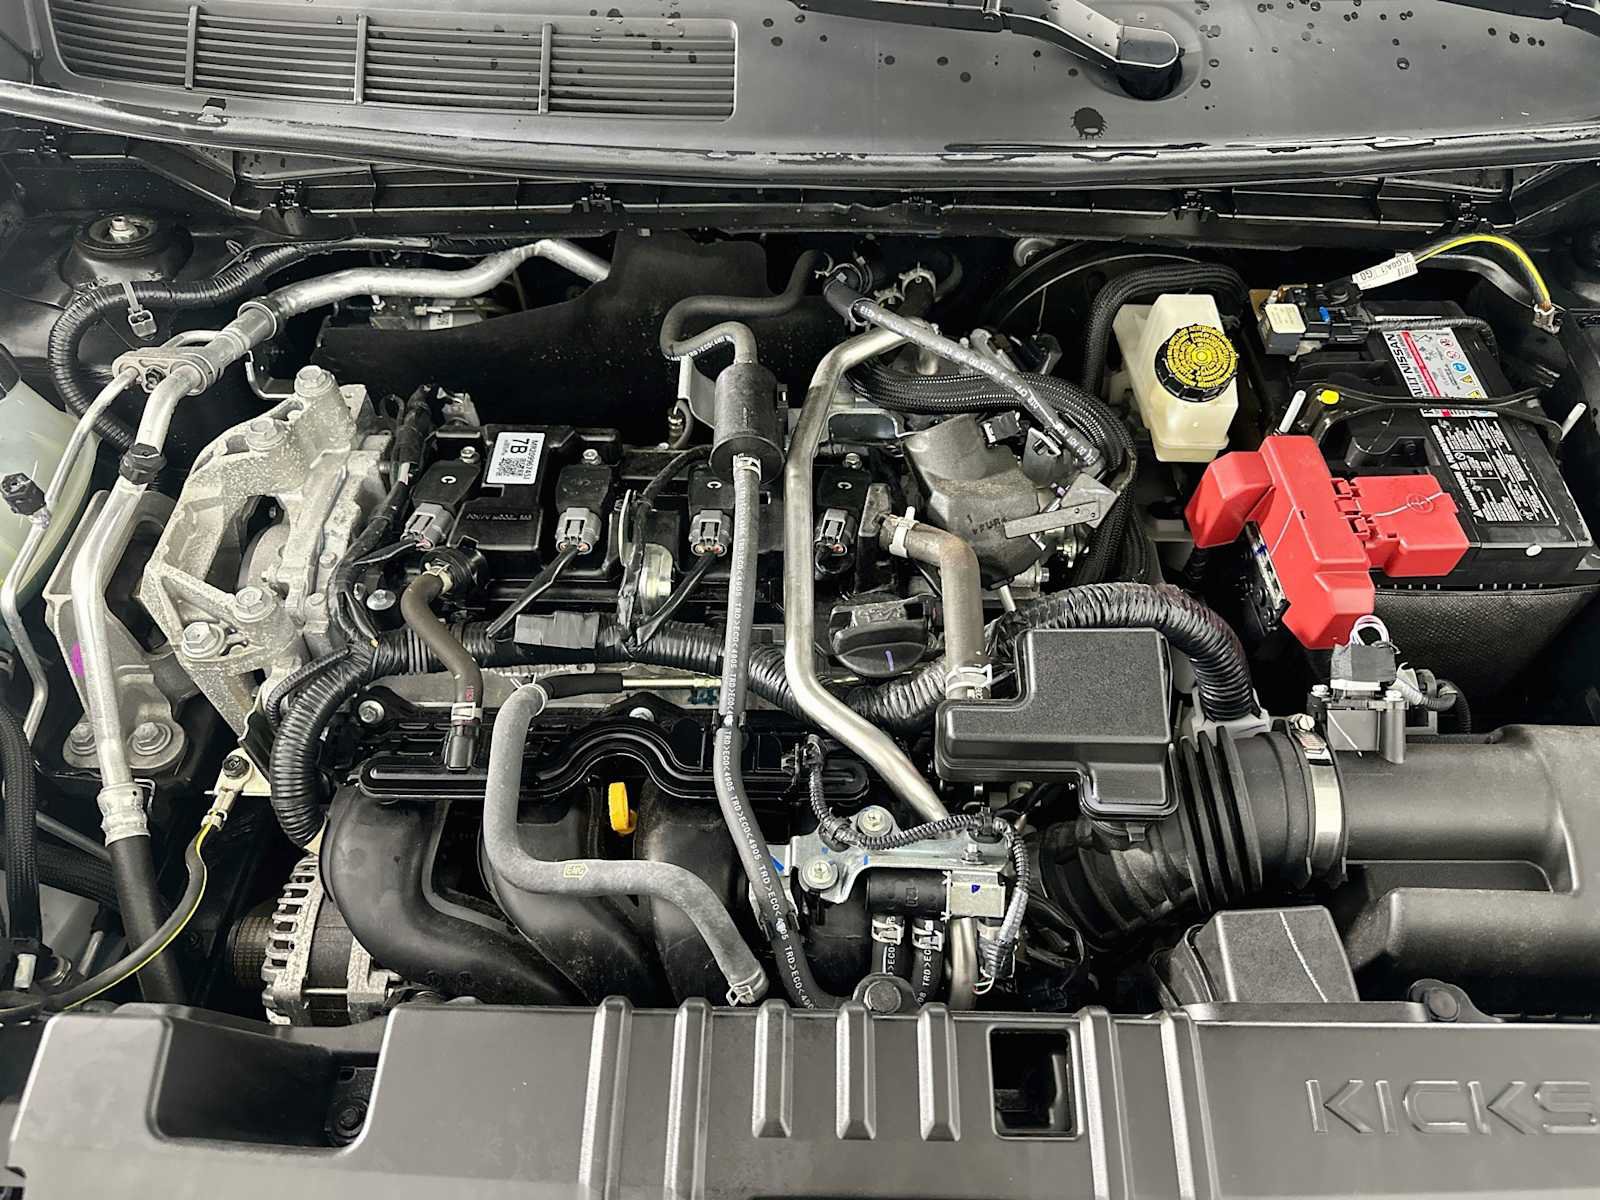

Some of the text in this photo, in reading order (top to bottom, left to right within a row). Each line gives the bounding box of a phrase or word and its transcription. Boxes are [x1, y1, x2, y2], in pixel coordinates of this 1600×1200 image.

[1385, 333, 1413, 375] NISSAN
[510, 438, 530, 454] 7B
[729, 795, 763, 861] TRD>ECO<4905
[1305, 1079, 1600, 1136] KICKS
